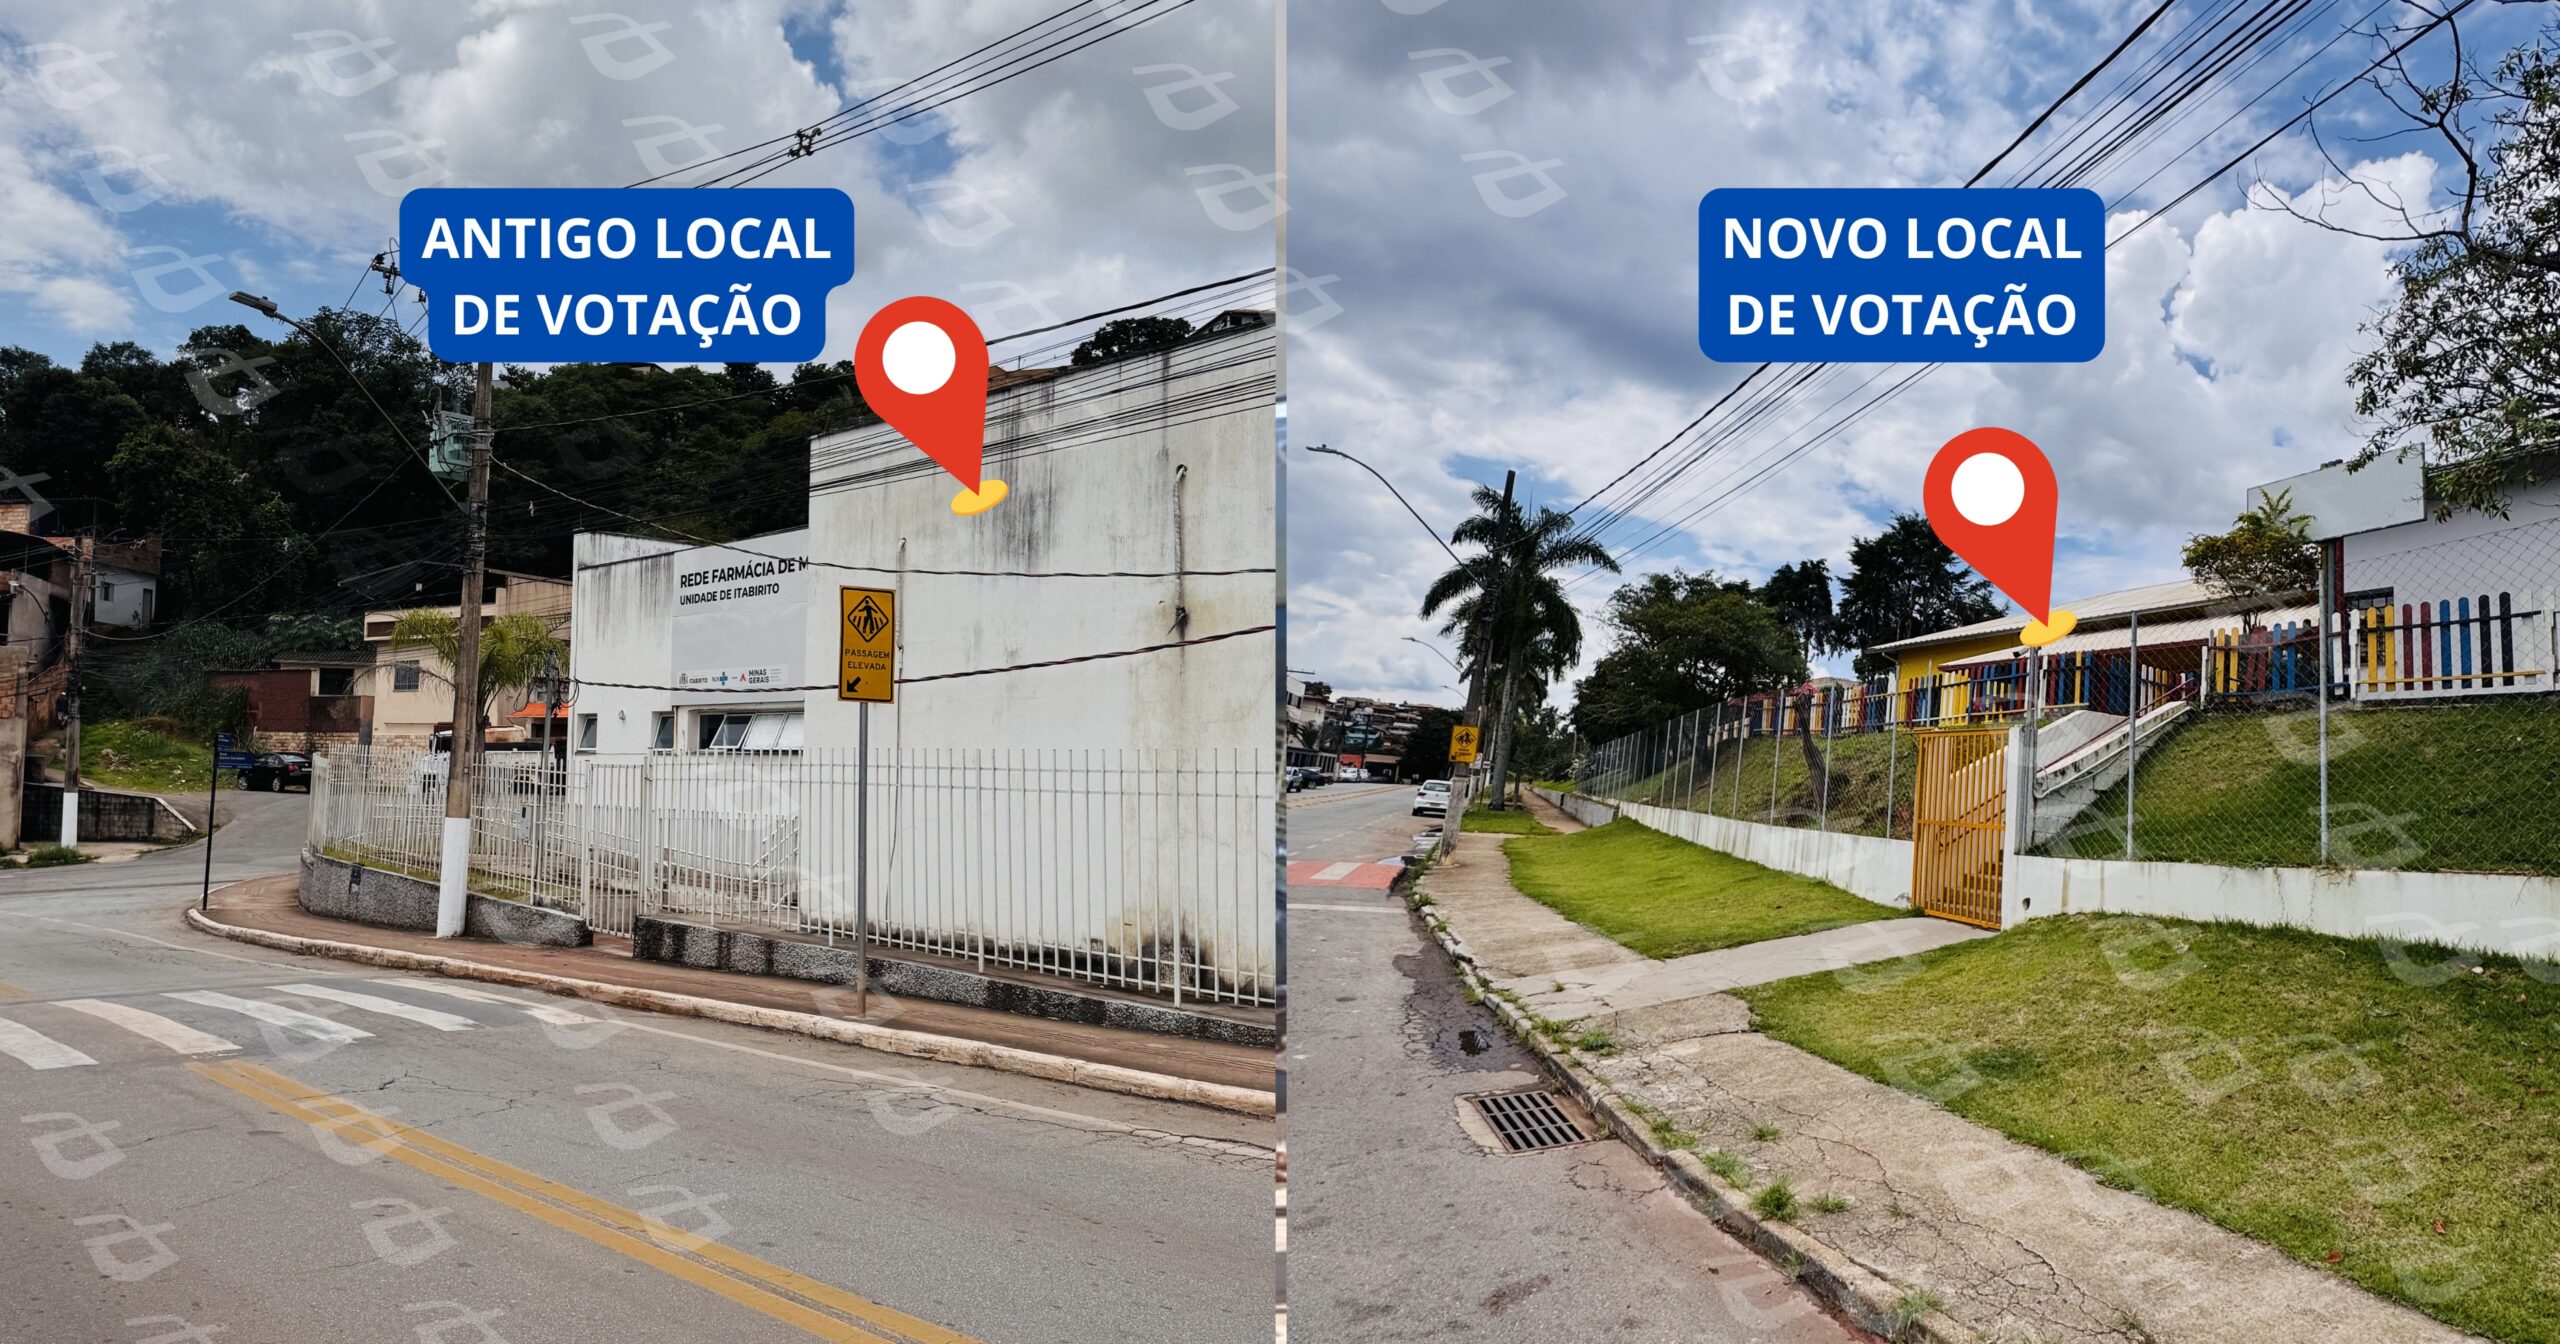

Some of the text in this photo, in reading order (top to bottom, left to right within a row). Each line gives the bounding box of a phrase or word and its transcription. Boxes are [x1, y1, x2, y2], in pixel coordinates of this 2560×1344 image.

[680, 570, 709, 588] REDE
[711, 560, 775, 583] FARMÁCIA
[778, 557, 795, 574] DE
[680, 583, 779, 605] UNIDADE DE ITABIRITO
[845, 648, 890, 659] PASSAGEM
[847, 661, 886, 670] ELEVADA
[748, 675, 770, 684] GERAIS
